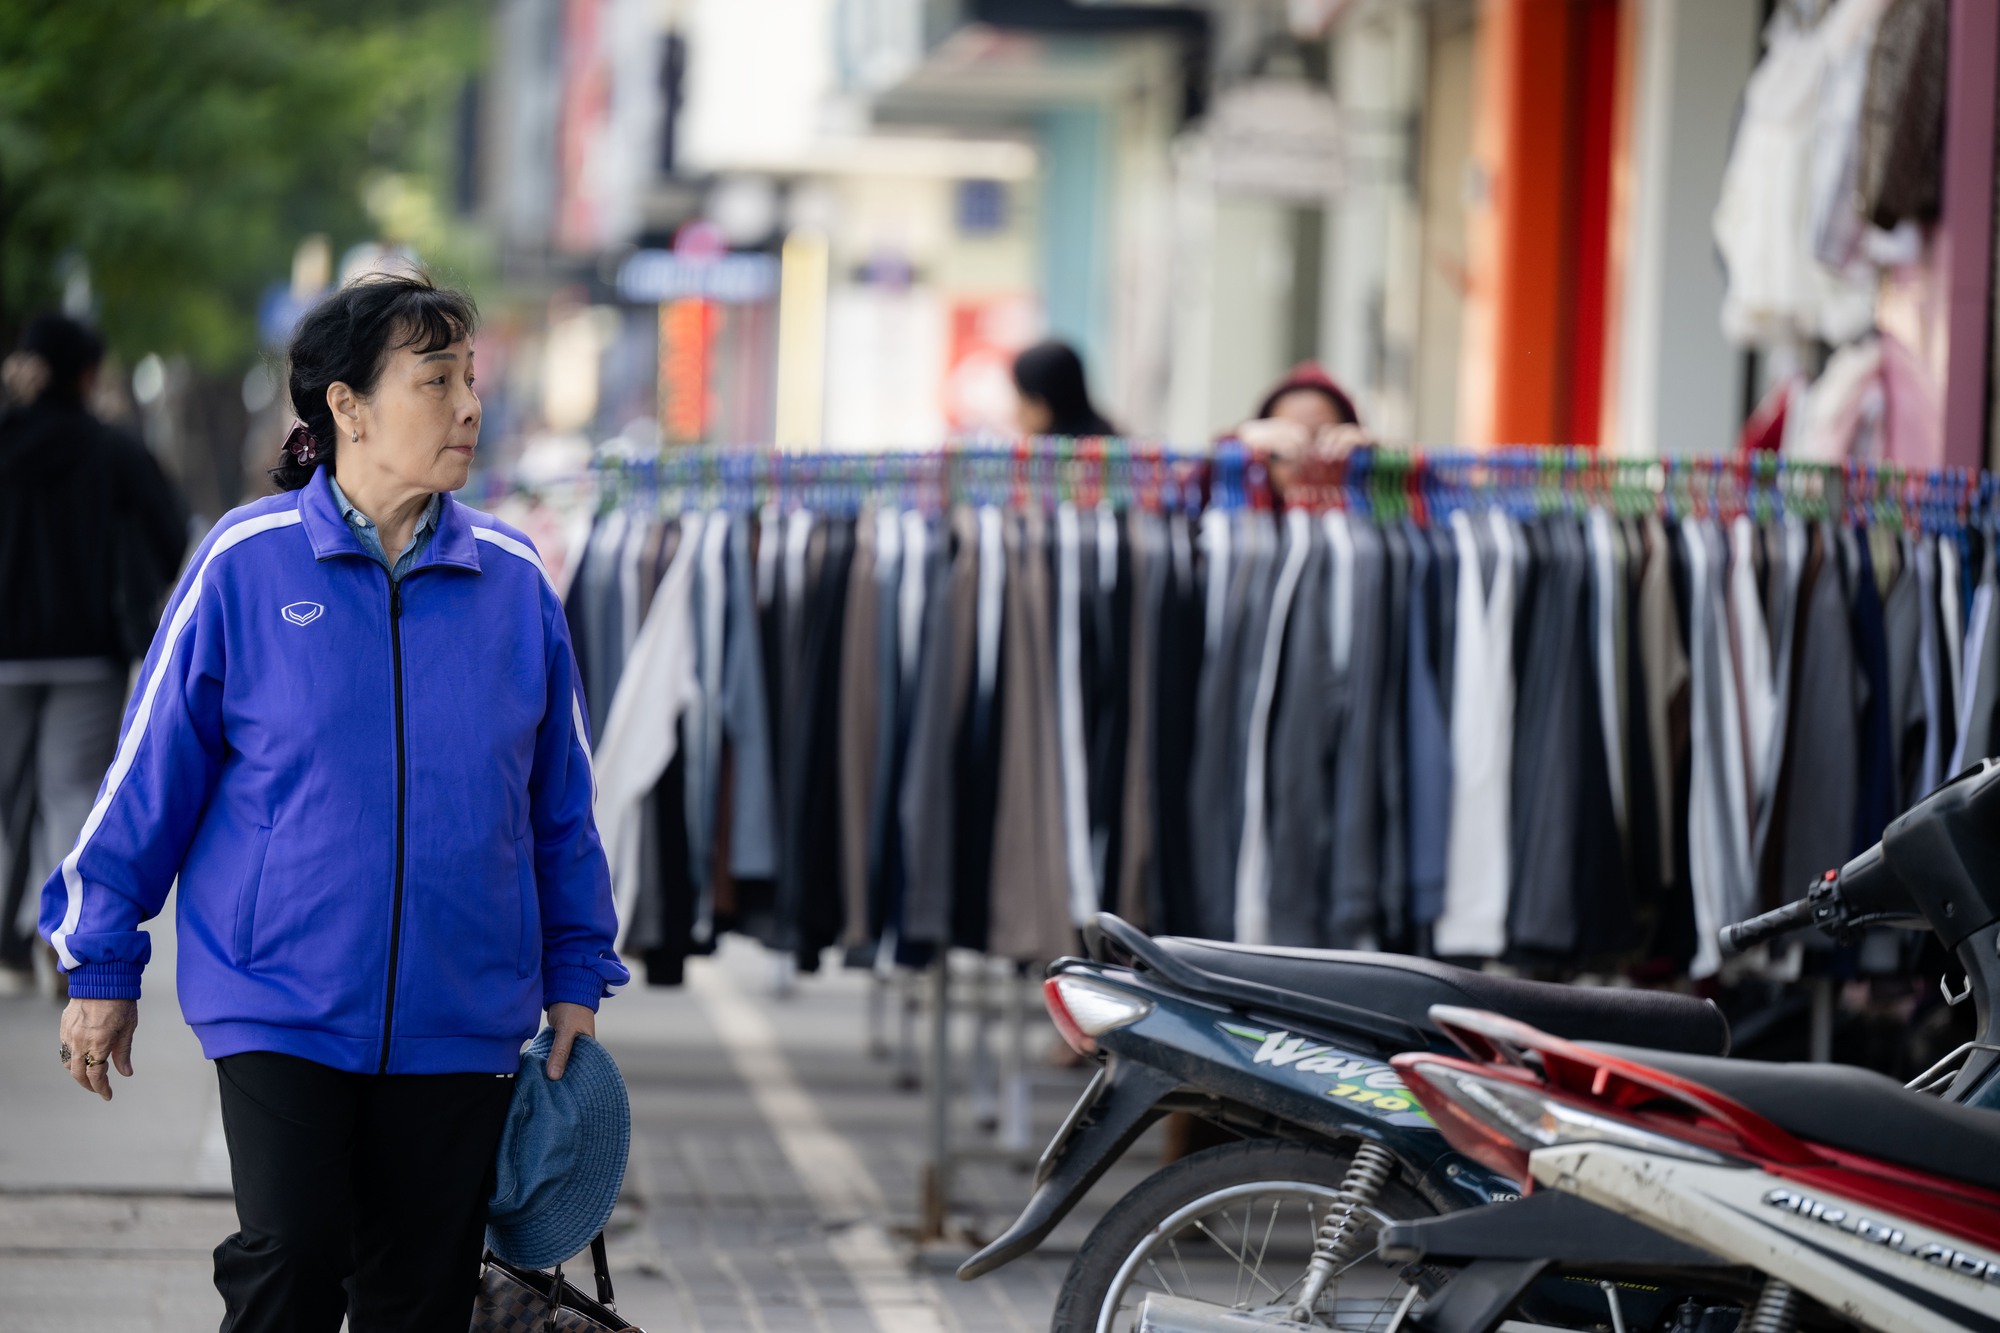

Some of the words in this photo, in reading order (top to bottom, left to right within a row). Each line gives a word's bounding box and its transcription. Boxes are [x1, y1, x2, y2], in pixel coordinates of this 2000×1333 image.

[1253, 1031, 1410, 1089] Wave
[1327, 1083, 1411, 1111] 110
[1762, 1187, 1847, 1227] AIR
